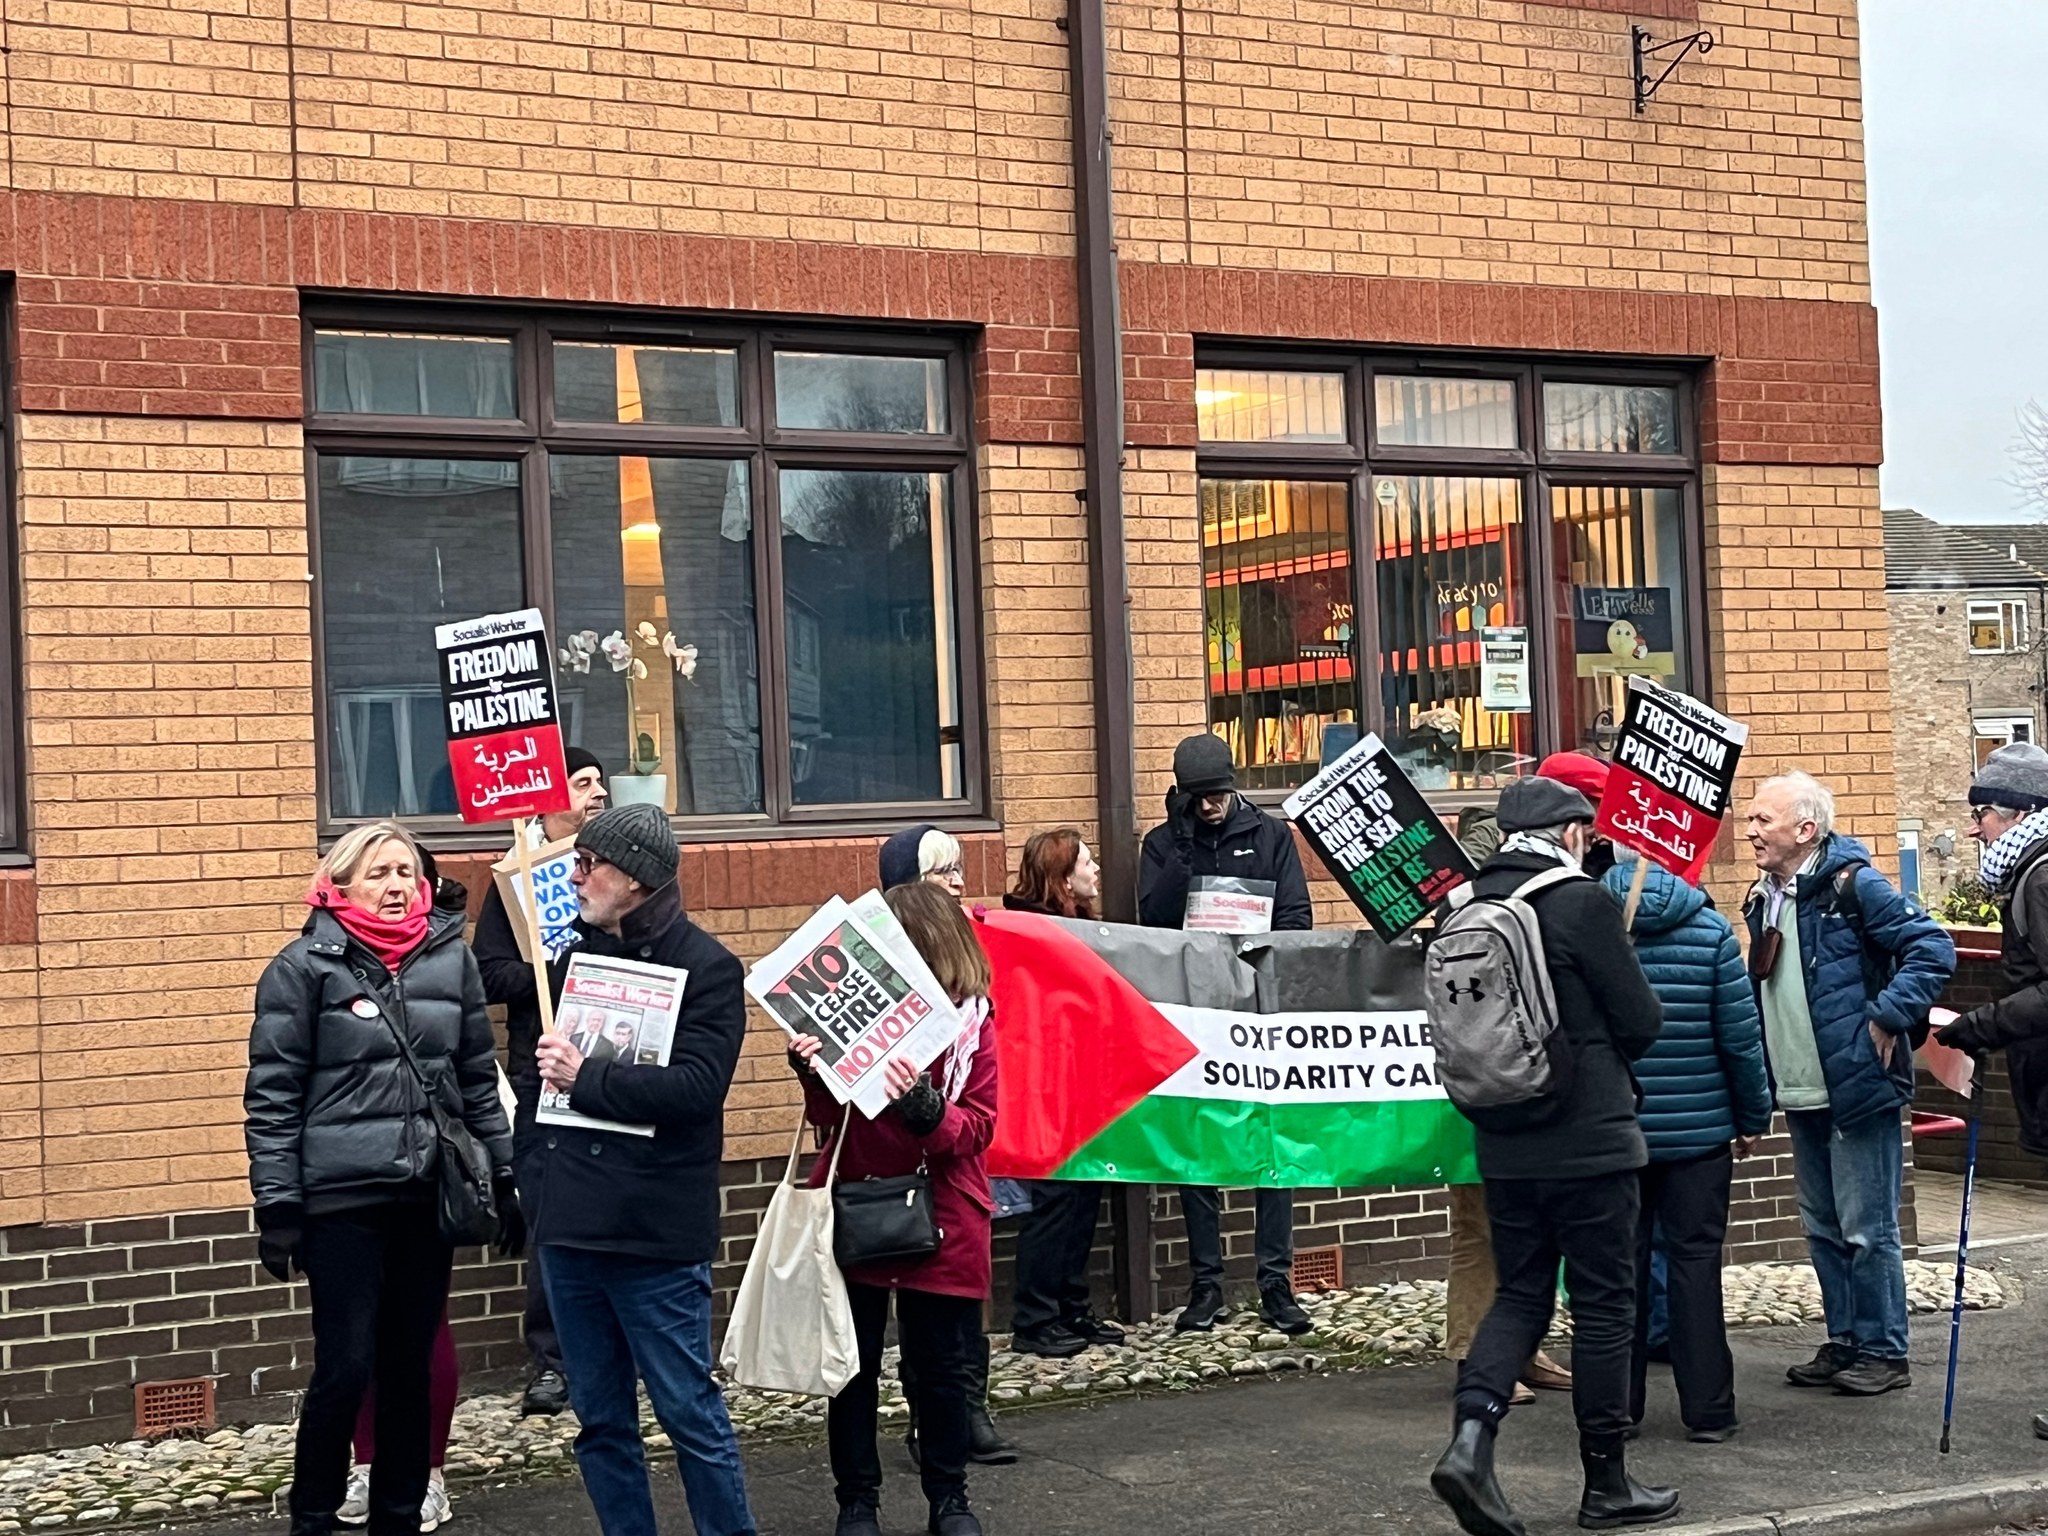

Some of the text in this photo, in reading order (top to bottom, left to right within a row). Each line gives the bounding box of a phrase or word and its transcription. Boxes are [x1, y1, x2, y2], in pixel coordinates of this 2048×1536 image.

[490, 619, 526, 635] Worker
[448, 639, 539, 684] FREEDOM
[449, 686, 550, 733] PALESTINE
[1690, 705, 1727, 734] Worker
[474, 736, 538, 772] الحرية
[1635, 699, 1728, 770] FREEDOM
[1667, 745, 1684, 762] for
[471, 766, 552, 807] لفلسطين
[1304, 761, 1388, 833] FROM THE
[1620, 735, 1722, 811] PALESTINE
[1318, 788, 1393, 853] RIVER TO
[1628, 781, 1692, 832] الحرية
[1332, 813, 1404, 871] THE SEA
[1350, 820, 1436, 893] PALESTINE
[1611, 809, 1696, 861] لفلسطين
[532, 862, 567, 886] NO
[1364, 874, 1409, 912] WILL
[1402, 854, 1432, 884] BE
[545, 898, 580, 922] ON
[1380, 892, 1425, 932] FREE
[625, 985, 674, 1008] Worker
[785, 945, 849, 1007] NO
[814, 968, 869, 1022] CEASE
[828, 985, 890, 1045] FIRE
[835, 1045, 874, 1083] NO
[865, 993, 930, 1051] VOTE
[1230, 1023, 1434, 1051] OXFORD PALE
[1203, 1059, 1375, 1090] SOLIDARITY
